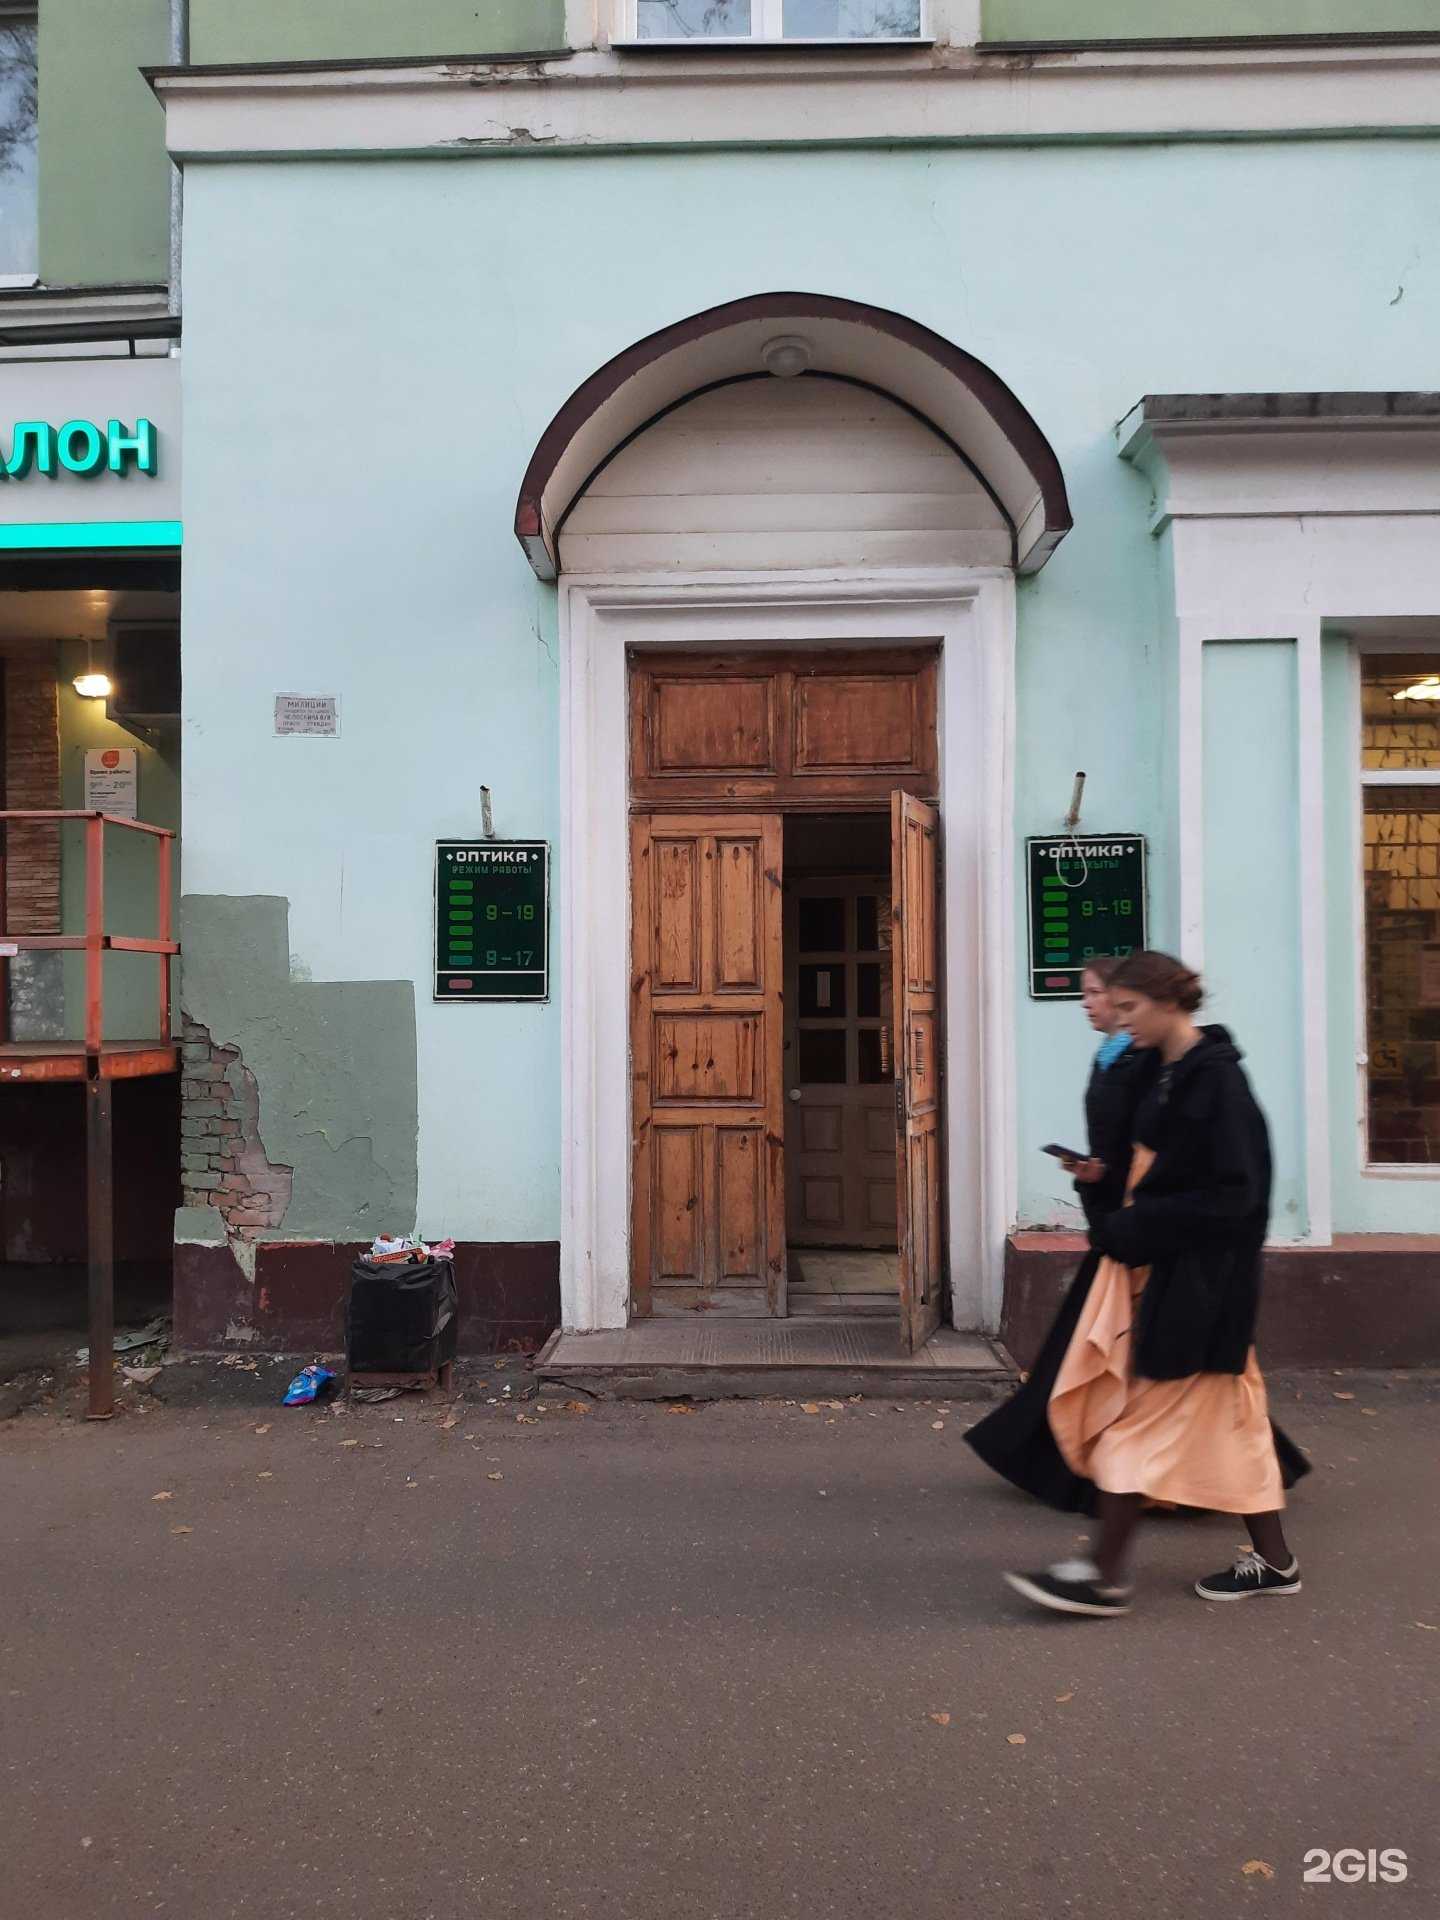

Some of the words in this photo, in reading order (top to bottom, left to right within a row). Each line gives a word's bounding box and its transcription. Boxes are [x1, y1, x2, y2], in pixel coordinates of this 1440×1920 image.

[0, 418, 156, 480] ЛОН
[456, 851, 527, 863] ОПТИКА
[1049, 845, 1123, 858] ОПТИКА
[452, 865, 489, 874] РЕЖИМ
[492, 865, 532, 874] РАБОТЫ
